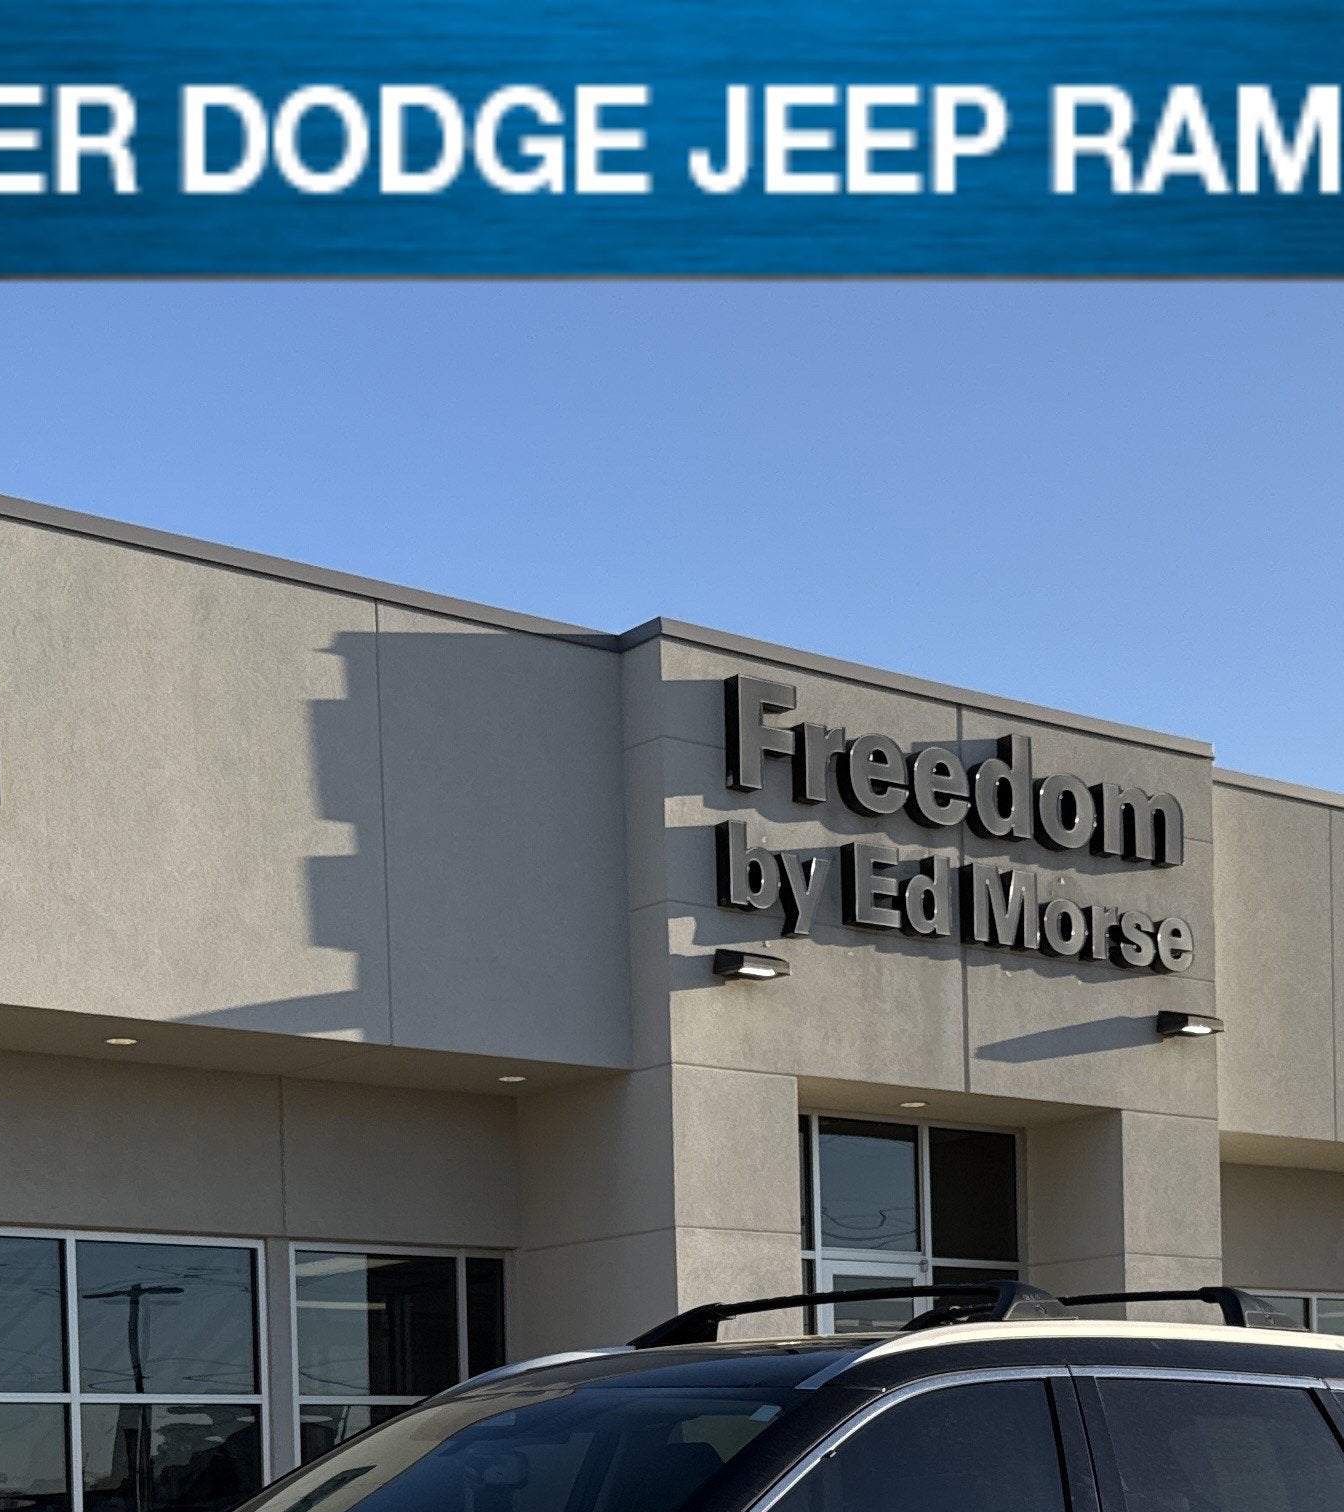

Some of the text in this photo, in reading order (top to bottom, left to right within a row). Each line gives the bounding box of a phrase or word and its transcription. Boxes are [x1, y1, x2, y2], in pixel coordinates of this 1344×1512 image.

[724, 674, 1184, 867] Freedom
[716, 820, 1194, 972] by Ed Morse
